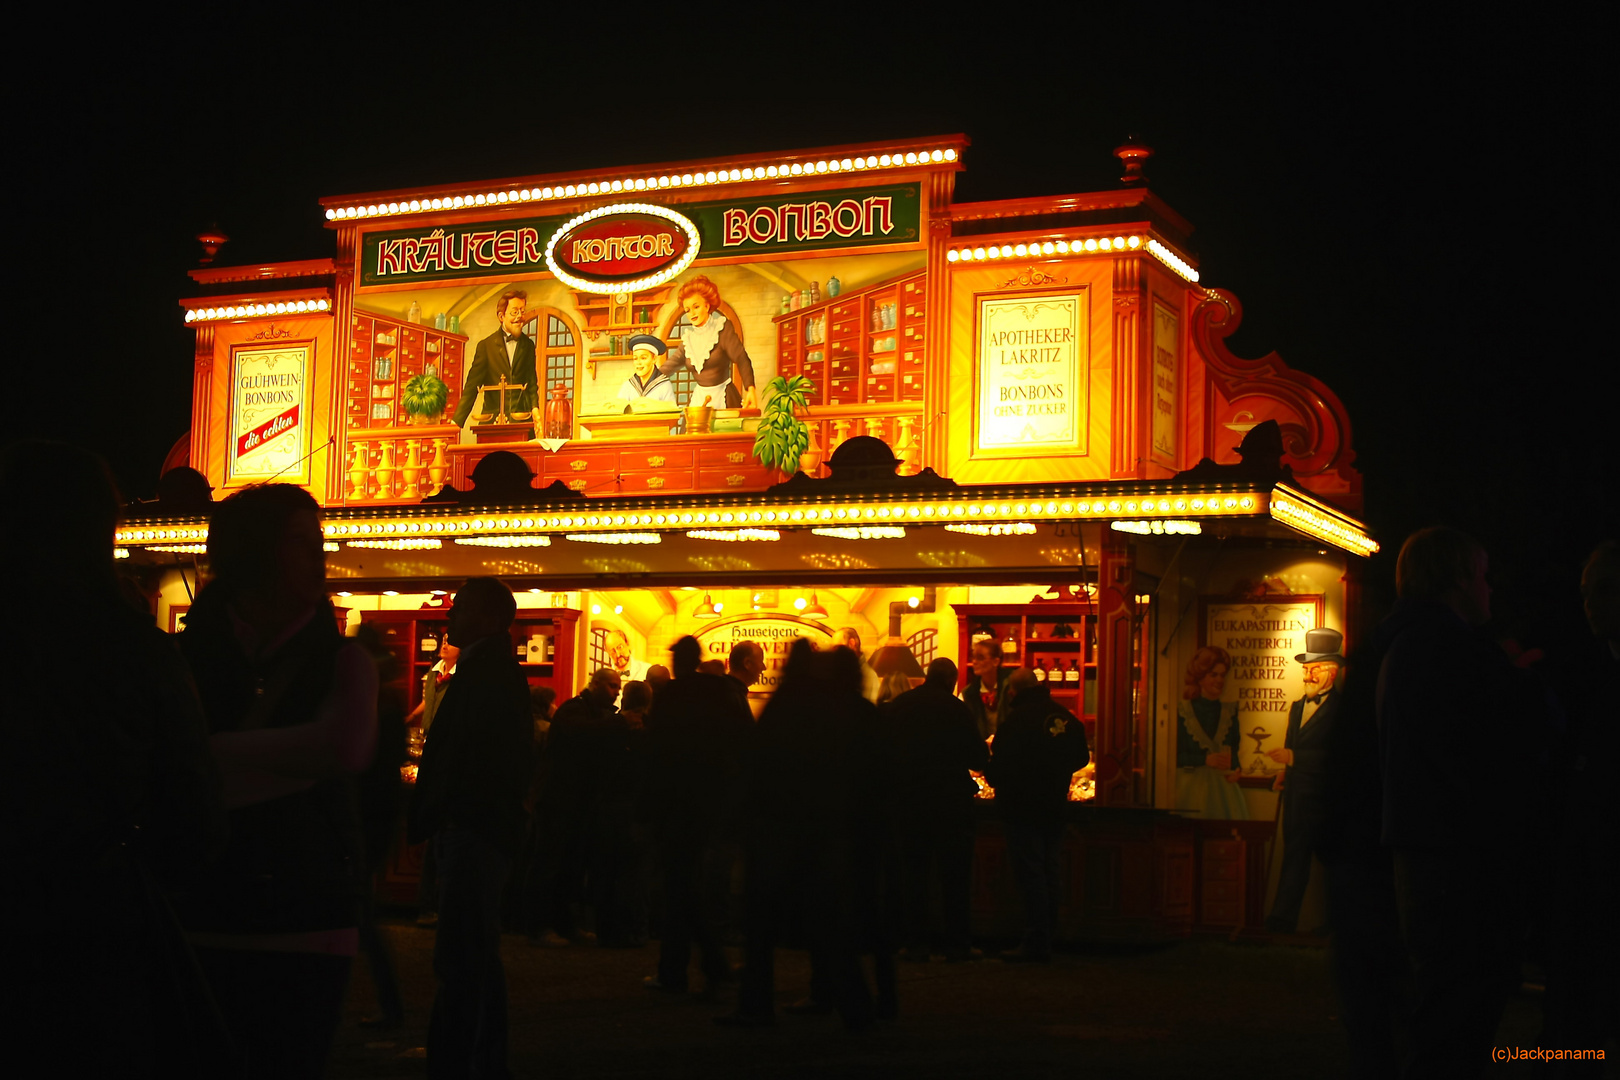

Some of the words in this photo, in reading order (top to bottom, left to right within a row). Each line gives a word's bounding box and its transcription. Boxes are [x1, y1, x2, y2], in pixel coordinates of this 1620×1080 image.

[376, 227, 542, 276] KRÄUTER
[571, 232, 676, 264] KONTOR
[723, 196, 895, 247] BONBON
[989, 327, 1075, 347] APOTHEKER-
[1001, 347, 1062, 366] LAKRITZ
[245, 390, 294, 405] BONBONS
[1000, 384, 1064, 402] BONBONS
[994, 404, 1023, 417] OHNE
[1026, 402, 1067, 417] ZUCKER
[244, 431, 260, 450] die
[262, 415, 293, 439] echten
[731, 625, 799, 640] Hauseigene
[1214, 620, 1305, 631] EUKAPASTILLEN
[1226, 636, 1292, 649] KNÖTERICH
[1231, 655, 1288, 667] KRÄUTER-
[1233, 669, 1285, 680] LAKRITZ
[1238, 687, 1286, 699] ECHTER-
